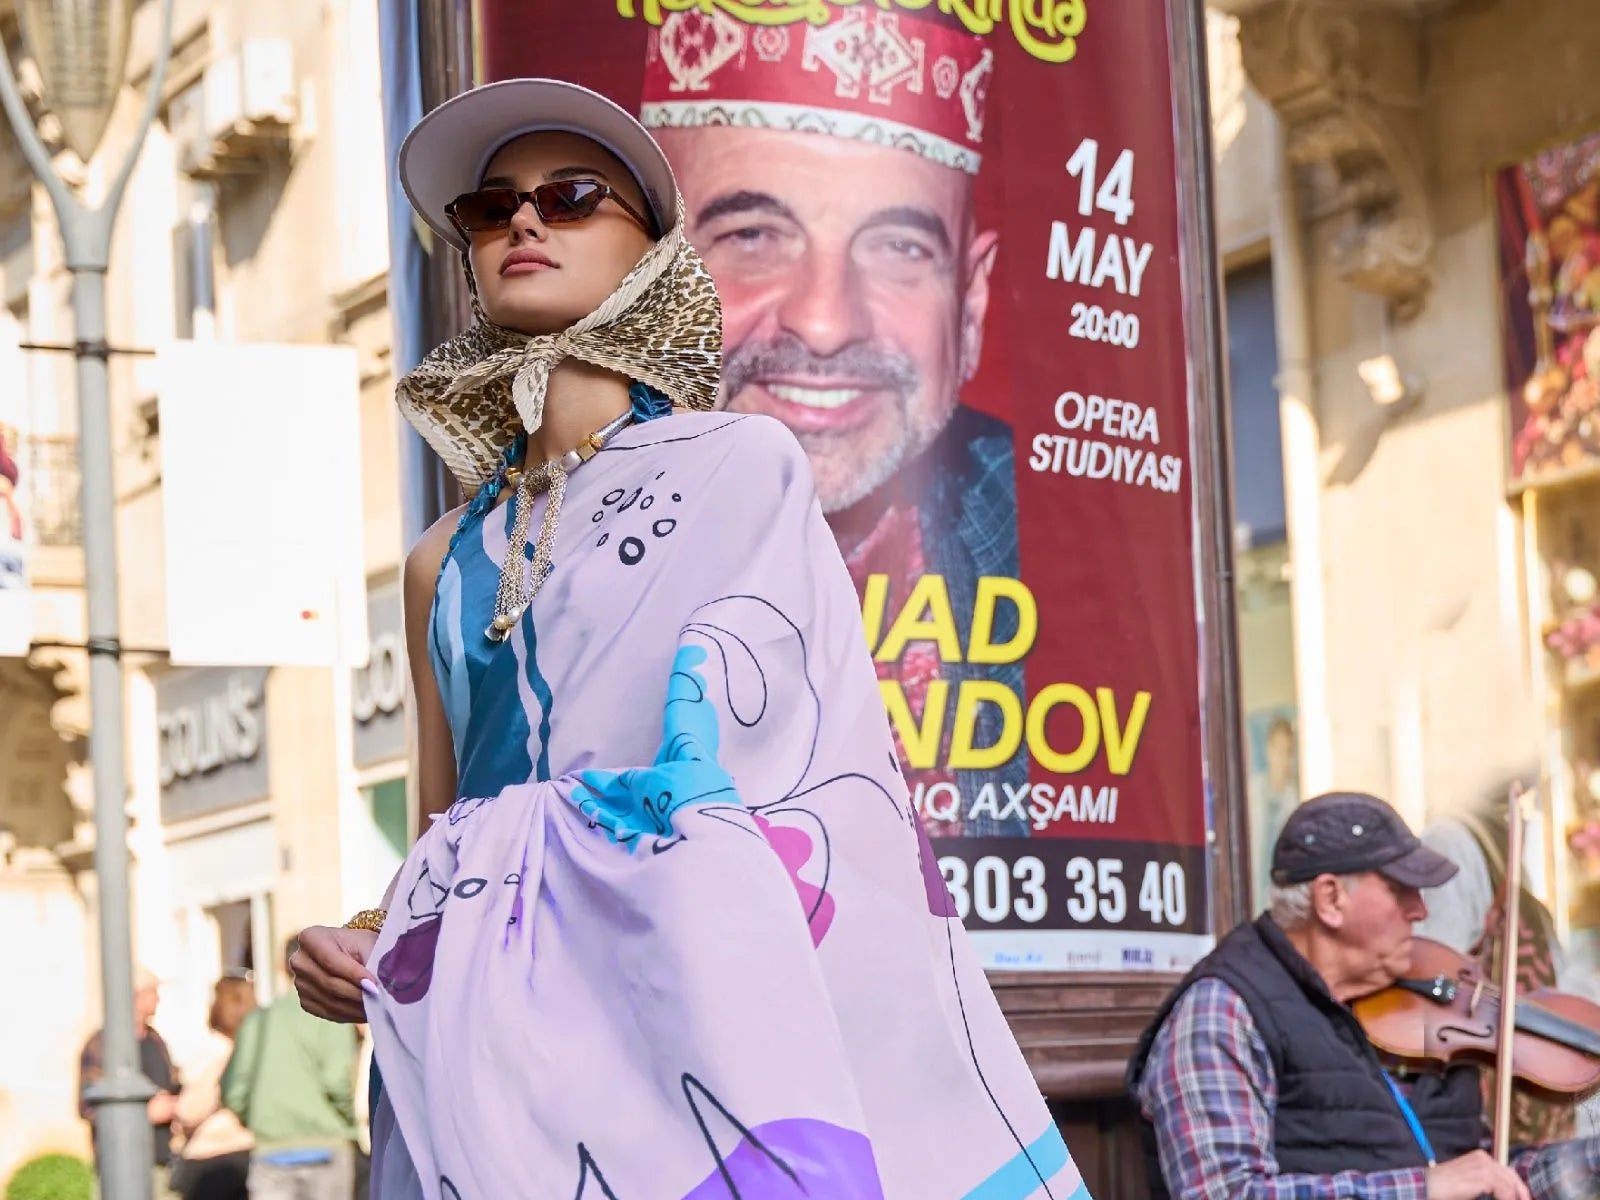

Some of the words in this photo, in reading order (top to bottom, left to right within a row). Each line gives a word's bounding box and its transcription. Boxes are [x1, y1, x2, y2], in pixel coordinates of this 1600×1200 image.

[1065, 138, 1135, 226] 14
[1045, 222, 1153, 297] MAY
[1069, 303, 1140, 348] 20:00
[1054, 391, 1159, 444] OPERA
[969, 783, 1118, 830] AXŞAMI
[1065, 856, 1127, 923] 35
[1139, 861, 1187, 925] 40
